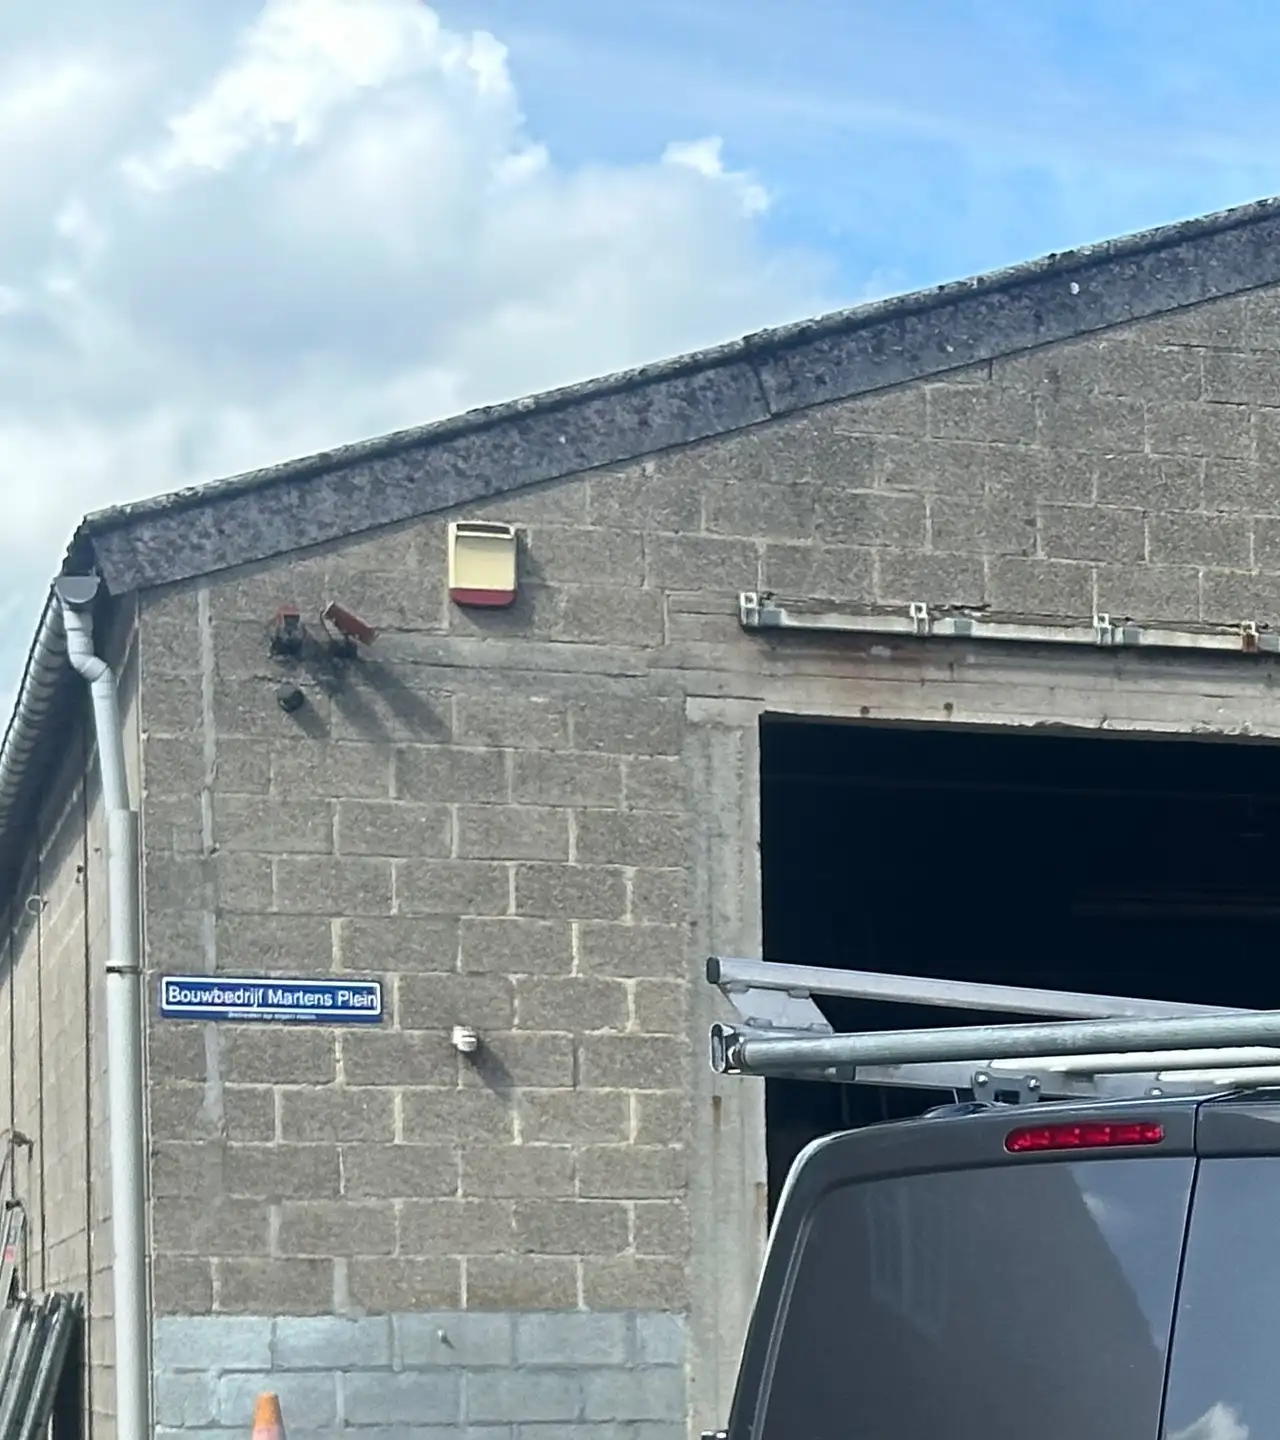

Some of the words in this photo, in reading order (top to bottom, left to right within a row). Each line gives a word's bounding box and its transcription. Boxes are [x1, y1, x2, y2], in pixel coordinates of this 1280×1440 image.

[168, 985, 264, 1008] Bouwbedrijf
[267, 988, 333, 1006] Martens
[337, 990, 377, 1007] Plein
